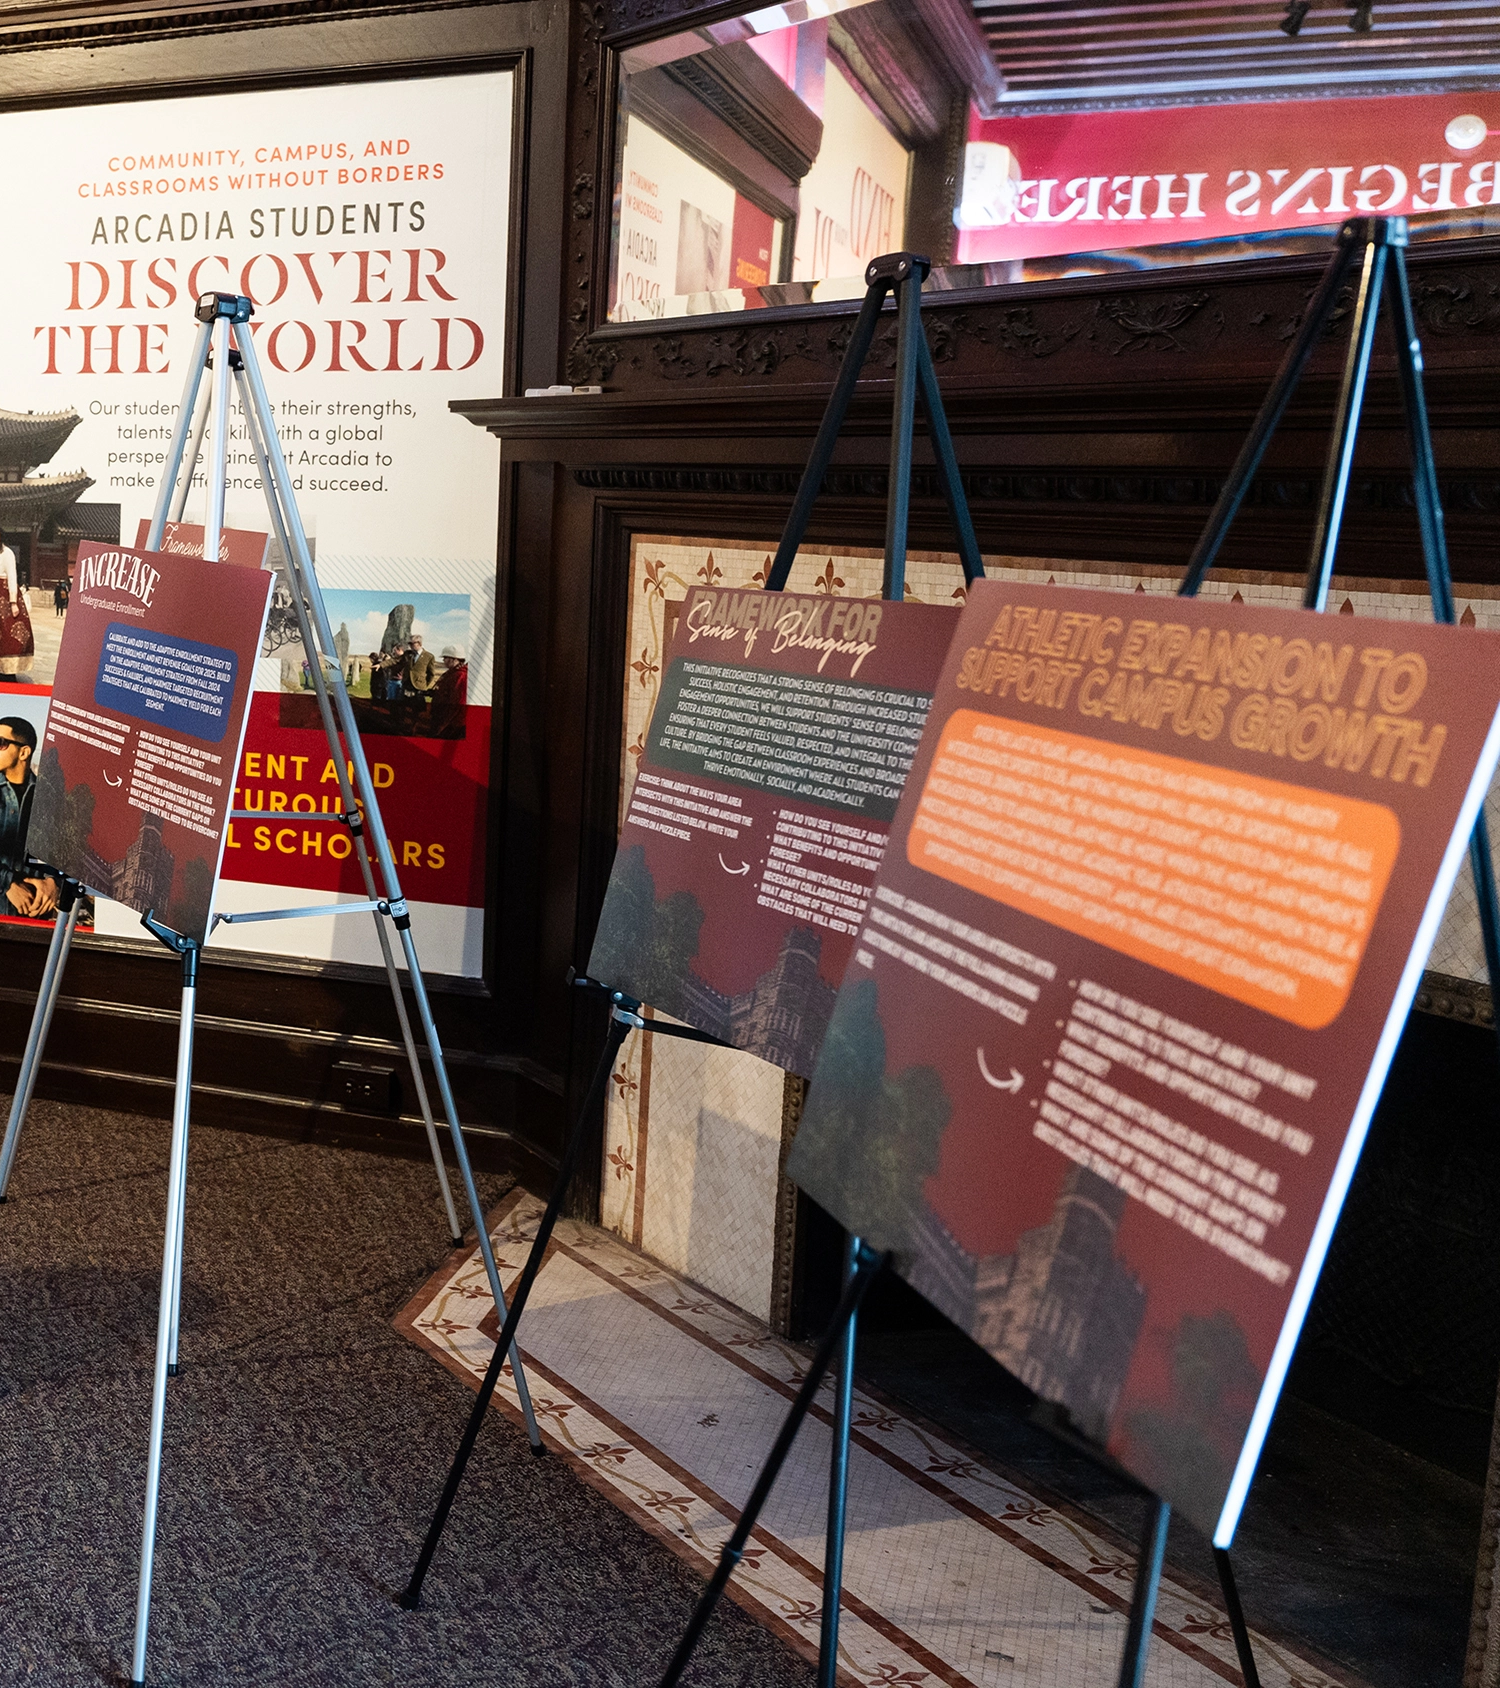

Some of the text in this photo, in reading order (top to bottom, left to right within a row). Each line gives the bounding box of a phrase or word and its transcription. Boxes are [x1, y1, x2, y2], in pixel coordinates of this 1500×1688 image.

[108, 139, 411, 172] COMMUNITY, CAMPUS, AND
[78, 163, 445, 198] CLASSROOMS WITHOUT BORDERS
[91, 201, 426, 245] ARCADIA STUDENTS
[64, 248, 459, 311] DISCOVER
[33, 324, 171, 374] THE
[89, 399, 417, 420] Our their strengths,
[118, 424, 383, 445] talents a global
[298, 450, 392, 466] Arcadia to
[110, 472, 388, 491] make succeed.
[78, 552, 161, 608] INCREASE
[80, 593, 145, 618] Undergraduate Enrollment
[691, 591, 883, 643] FRAMEWORK FOR
[686, 601, 877, 678] Sense of Belonging
[984, 604, 1428, 715] ATHLETIC EXPANSION TO
[956, 646, 1448, 788] SUPPORT CAMPUS GROWTH
